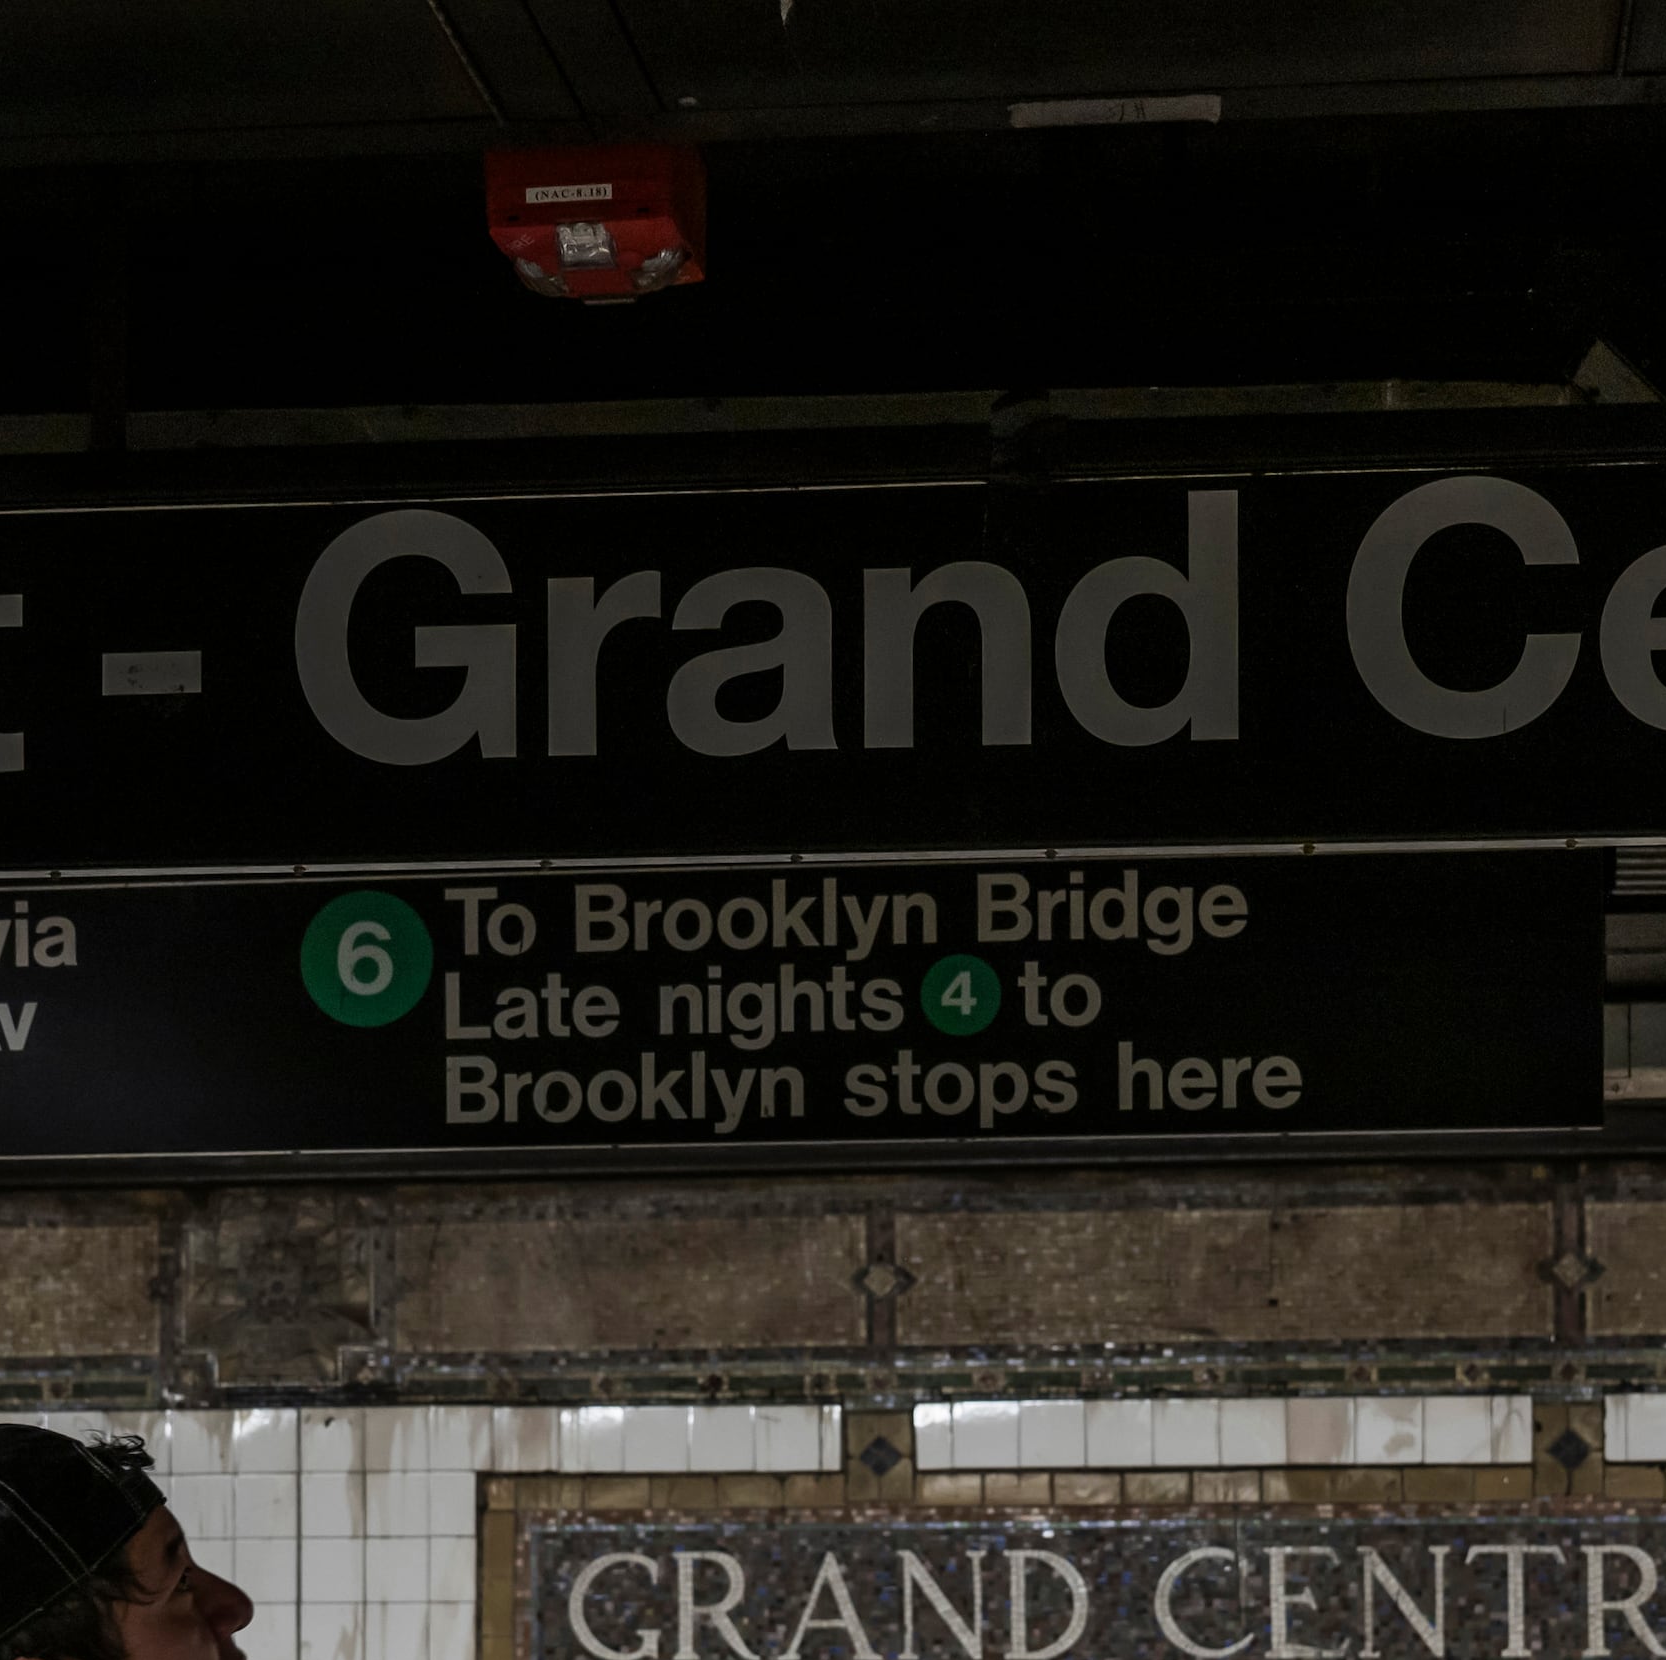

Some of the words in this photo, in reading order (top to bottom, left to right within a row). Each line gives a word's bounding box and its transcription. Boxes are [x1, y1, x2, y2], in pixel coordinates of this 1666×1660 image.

[294, 488, 1244, 767] Grand
[337, 921, 394, 996] 6
[444, 886, 537, 957] To
[574, 877, 938, 961] Brooklyn
[977, 869, 1249, 956] Bridge
[444, 971, 621, 1040] Late
[659, 964, 905, 1051] nights
[940, 970, 979, 1016] 4
[1017, 960, 1102, 1027] to
[445, 1049, 805, 1134] Brooklyn
[843, 1049, 1079, 1129] stops
[1118, 1040, 1303, 1111] here
